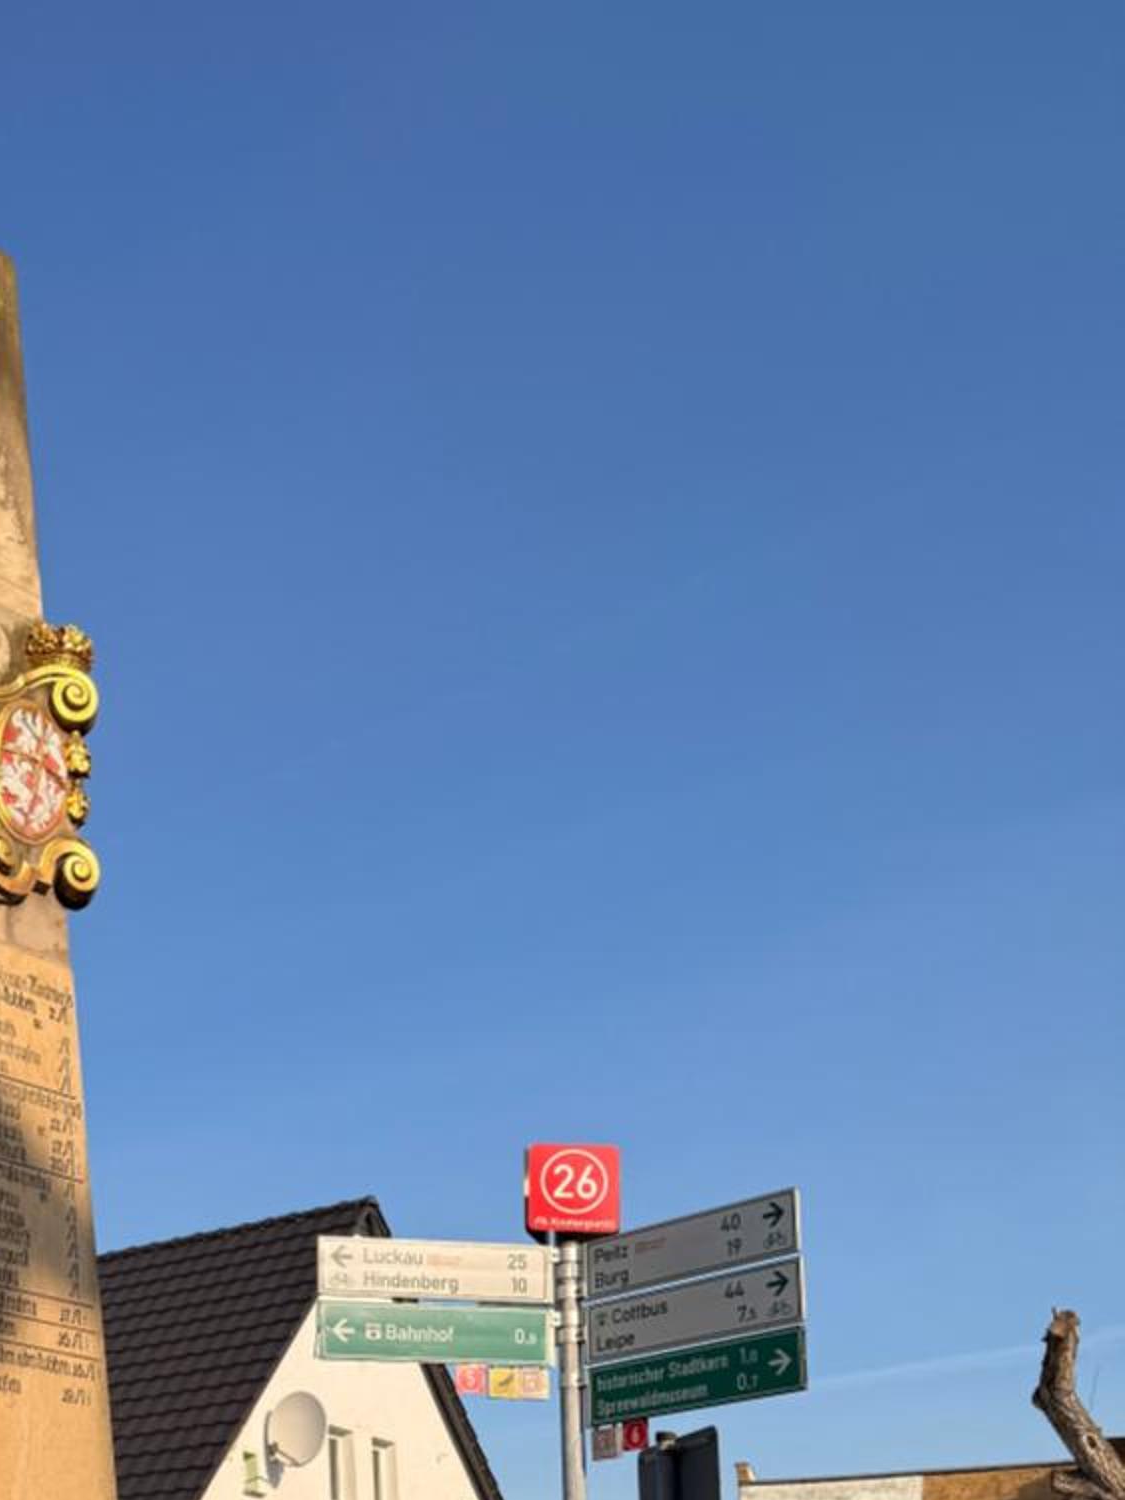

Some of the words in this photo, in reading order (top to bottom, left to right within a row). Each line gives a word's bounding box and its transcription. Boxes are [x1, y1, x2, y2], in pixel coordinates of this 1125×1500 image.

[552, 1163, 598, 1200] 26
[720, 1212, 742, 1232] 40
[362, 1247, 424, 1266] Luckau
[507, 1253, 528, 1271] 25
[362, 1269, 460, 1294] Hindenberg
[510, 1277, 528, 1294] 10
[594, 1269, 630, 1290] Burg
[724, 1280, 745, 1299] 44
[611, 1301, 668, 1325] Cottbus
[385, 1323, 456, 1343] Bahnhof
[596, 1366, 666, 1393] historischer
[667, 1353, 730, 1379] Stadtkern
[596, 1383, 709, 1418] Spreewaldmuseum
